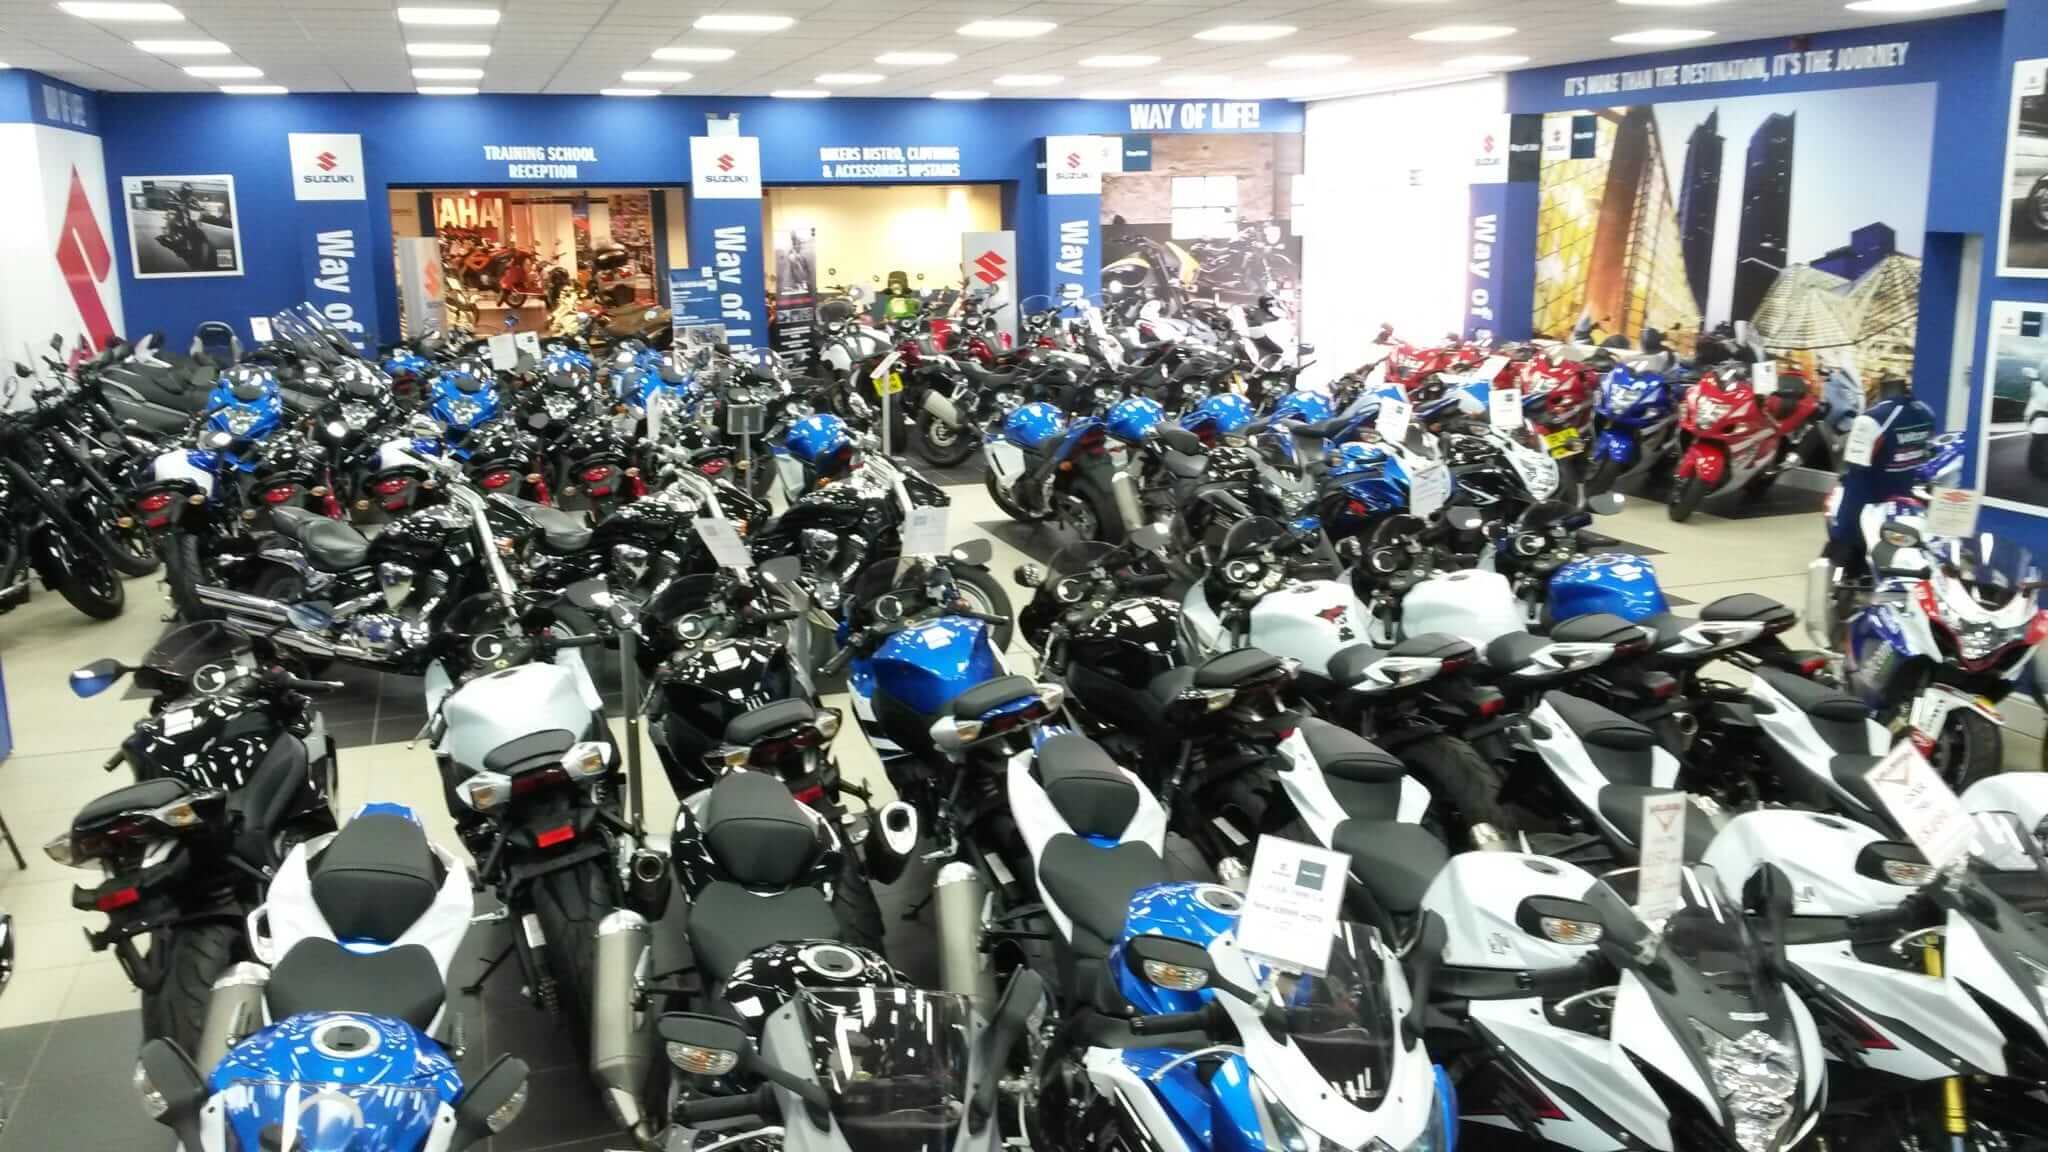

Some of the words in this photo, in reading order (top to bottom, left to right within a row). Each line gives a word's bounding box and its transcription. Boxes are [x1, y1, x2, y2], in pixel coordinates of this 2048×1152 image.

[1621, 69, 1654, 92] THAN
[1655, 65, 1680, 87] THE
[1804, 50, 1833, 73] THE
[1835, 41, 1909, 71] JOURNEY
[1129, 103, 1175, 129] WAY
[1181, 103, 1207, 129] OF
[1211, 103, 1260, 129] LIFE!
[483, 145, 545, 161] TRAINING
[547, 146, 598, 162] SCHOOL
[304, 175, 354, 184] SUZUKI
[508, 164, 577, 178] RECEPTION
[705, 174, 748, 183] SUZUKI
[822, 165, 832, 178] &
[835, 164, 907, 178] ACCESSORIES
[434, 198, 498, 229] AHA
[314, 229, 355, 293] Way
[714, 226, 747, 284] Way
[1056, 220, 1089, 275] Way
[1469, 214, 1497, 279] Way
[721, 293, 751, 321] of
[1471, 288, 1493, 321] of
